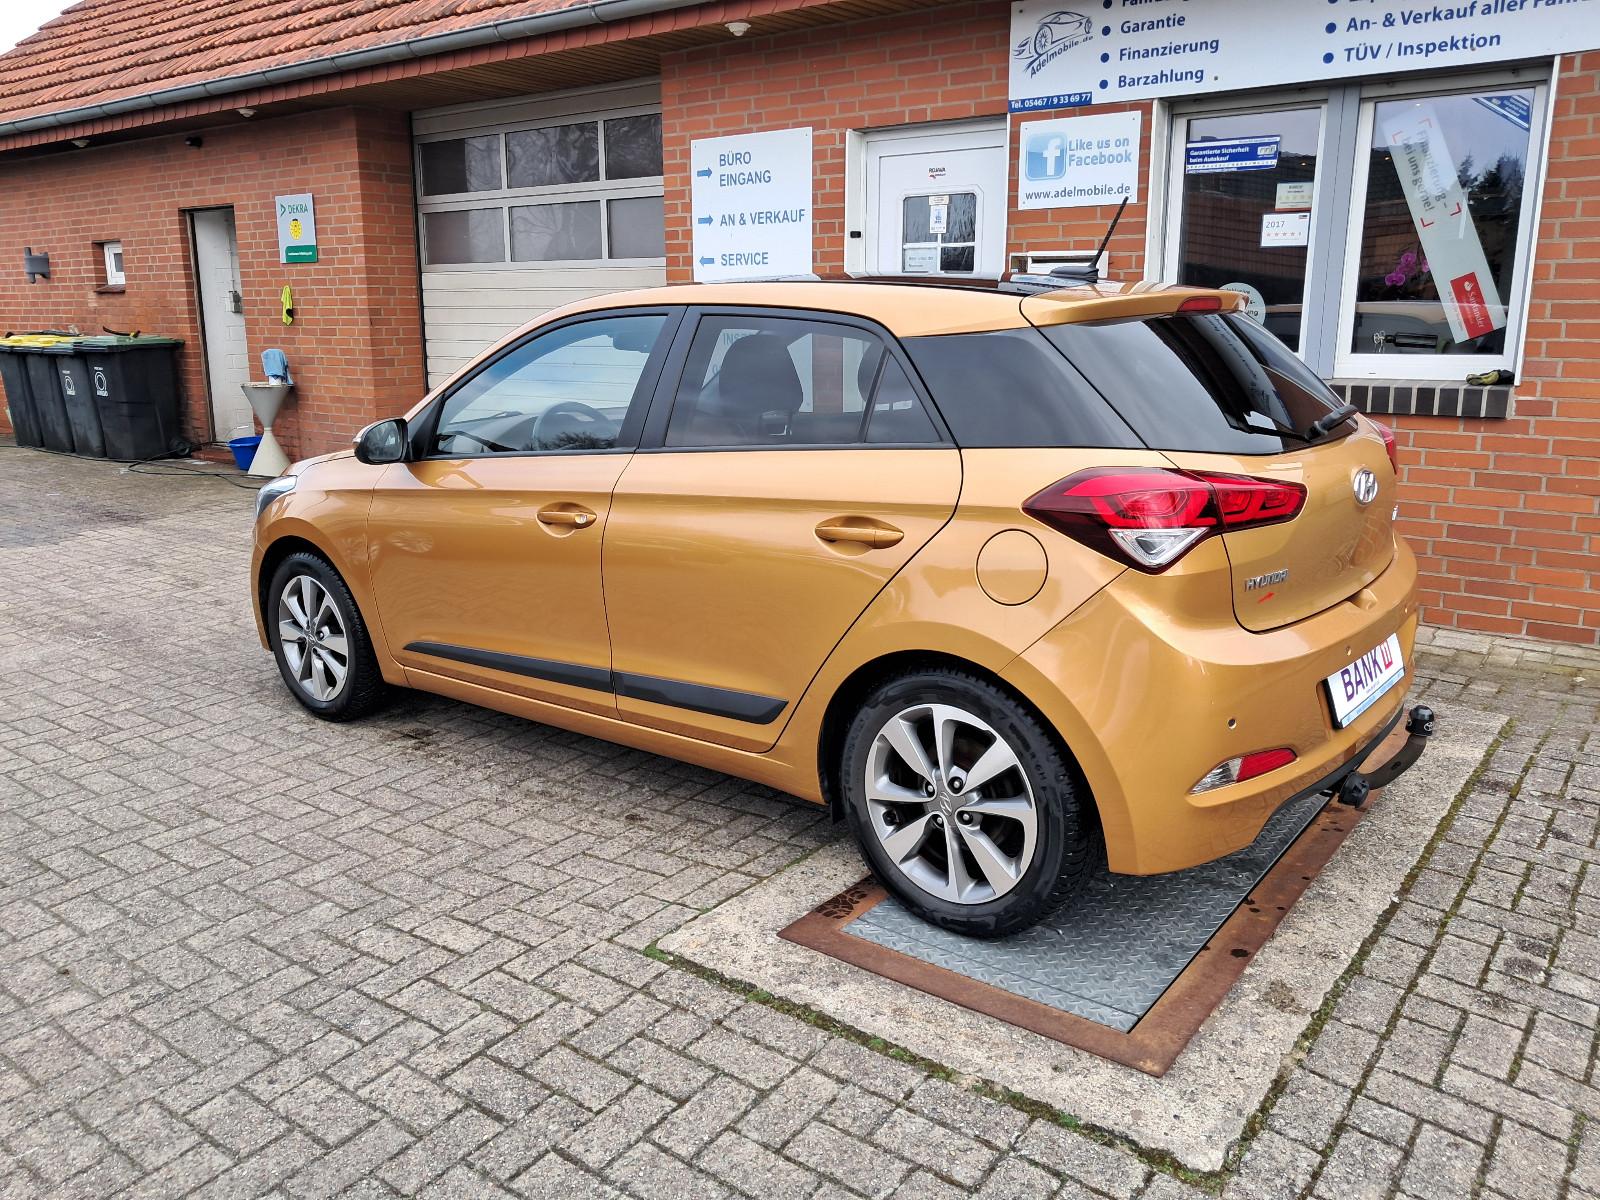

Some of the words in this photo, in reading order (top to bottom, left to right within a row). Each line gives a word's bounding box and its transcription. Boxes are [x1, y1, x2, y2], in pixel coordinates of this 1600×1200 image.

[1120, 13, 1186, 34] Garantie
[1346, 17, 1378, 33] An-
[1382, 12, 1395, 28] &
[1401, 1, 1477, 26] Verkauf
[1481, 0, 1525, 16] aller
[1119, 38, 1220, 61] Finanzierung
[1344, 42, 1382, 62] TÜV
[1386, 43, 1394, 59] /
[1398, 32, 1501, 57] Inspektion
[1118, 67, 1205, 89] Barzahlung
[1011, 100, 1024, 109] Tel.
[1024, 98, 1047, 108] 05467
[1069, 137, 1093, 152] Like
[1097, 138, 1111, 149] us
[1114, 136, 1130, 148] on
[719, 150, 752, 167] BÜRO
[1069, 148, 1132, 167] Facebook
[1408, 156, 1420, 176] uns
[719, 169, 772, 187] EINGANG
[1025, 183, 1131, 200] www.adelmobile.de
[287, 203, 309, 214] DEKRA
[720, 212, 736, 227] AN
[739, 212, 747, 226] &
[750, 209, 806, 225] VERKAUF
[1265, 220, 1285, 229] 2017
[720, 251, 769, 267] SERVICE
